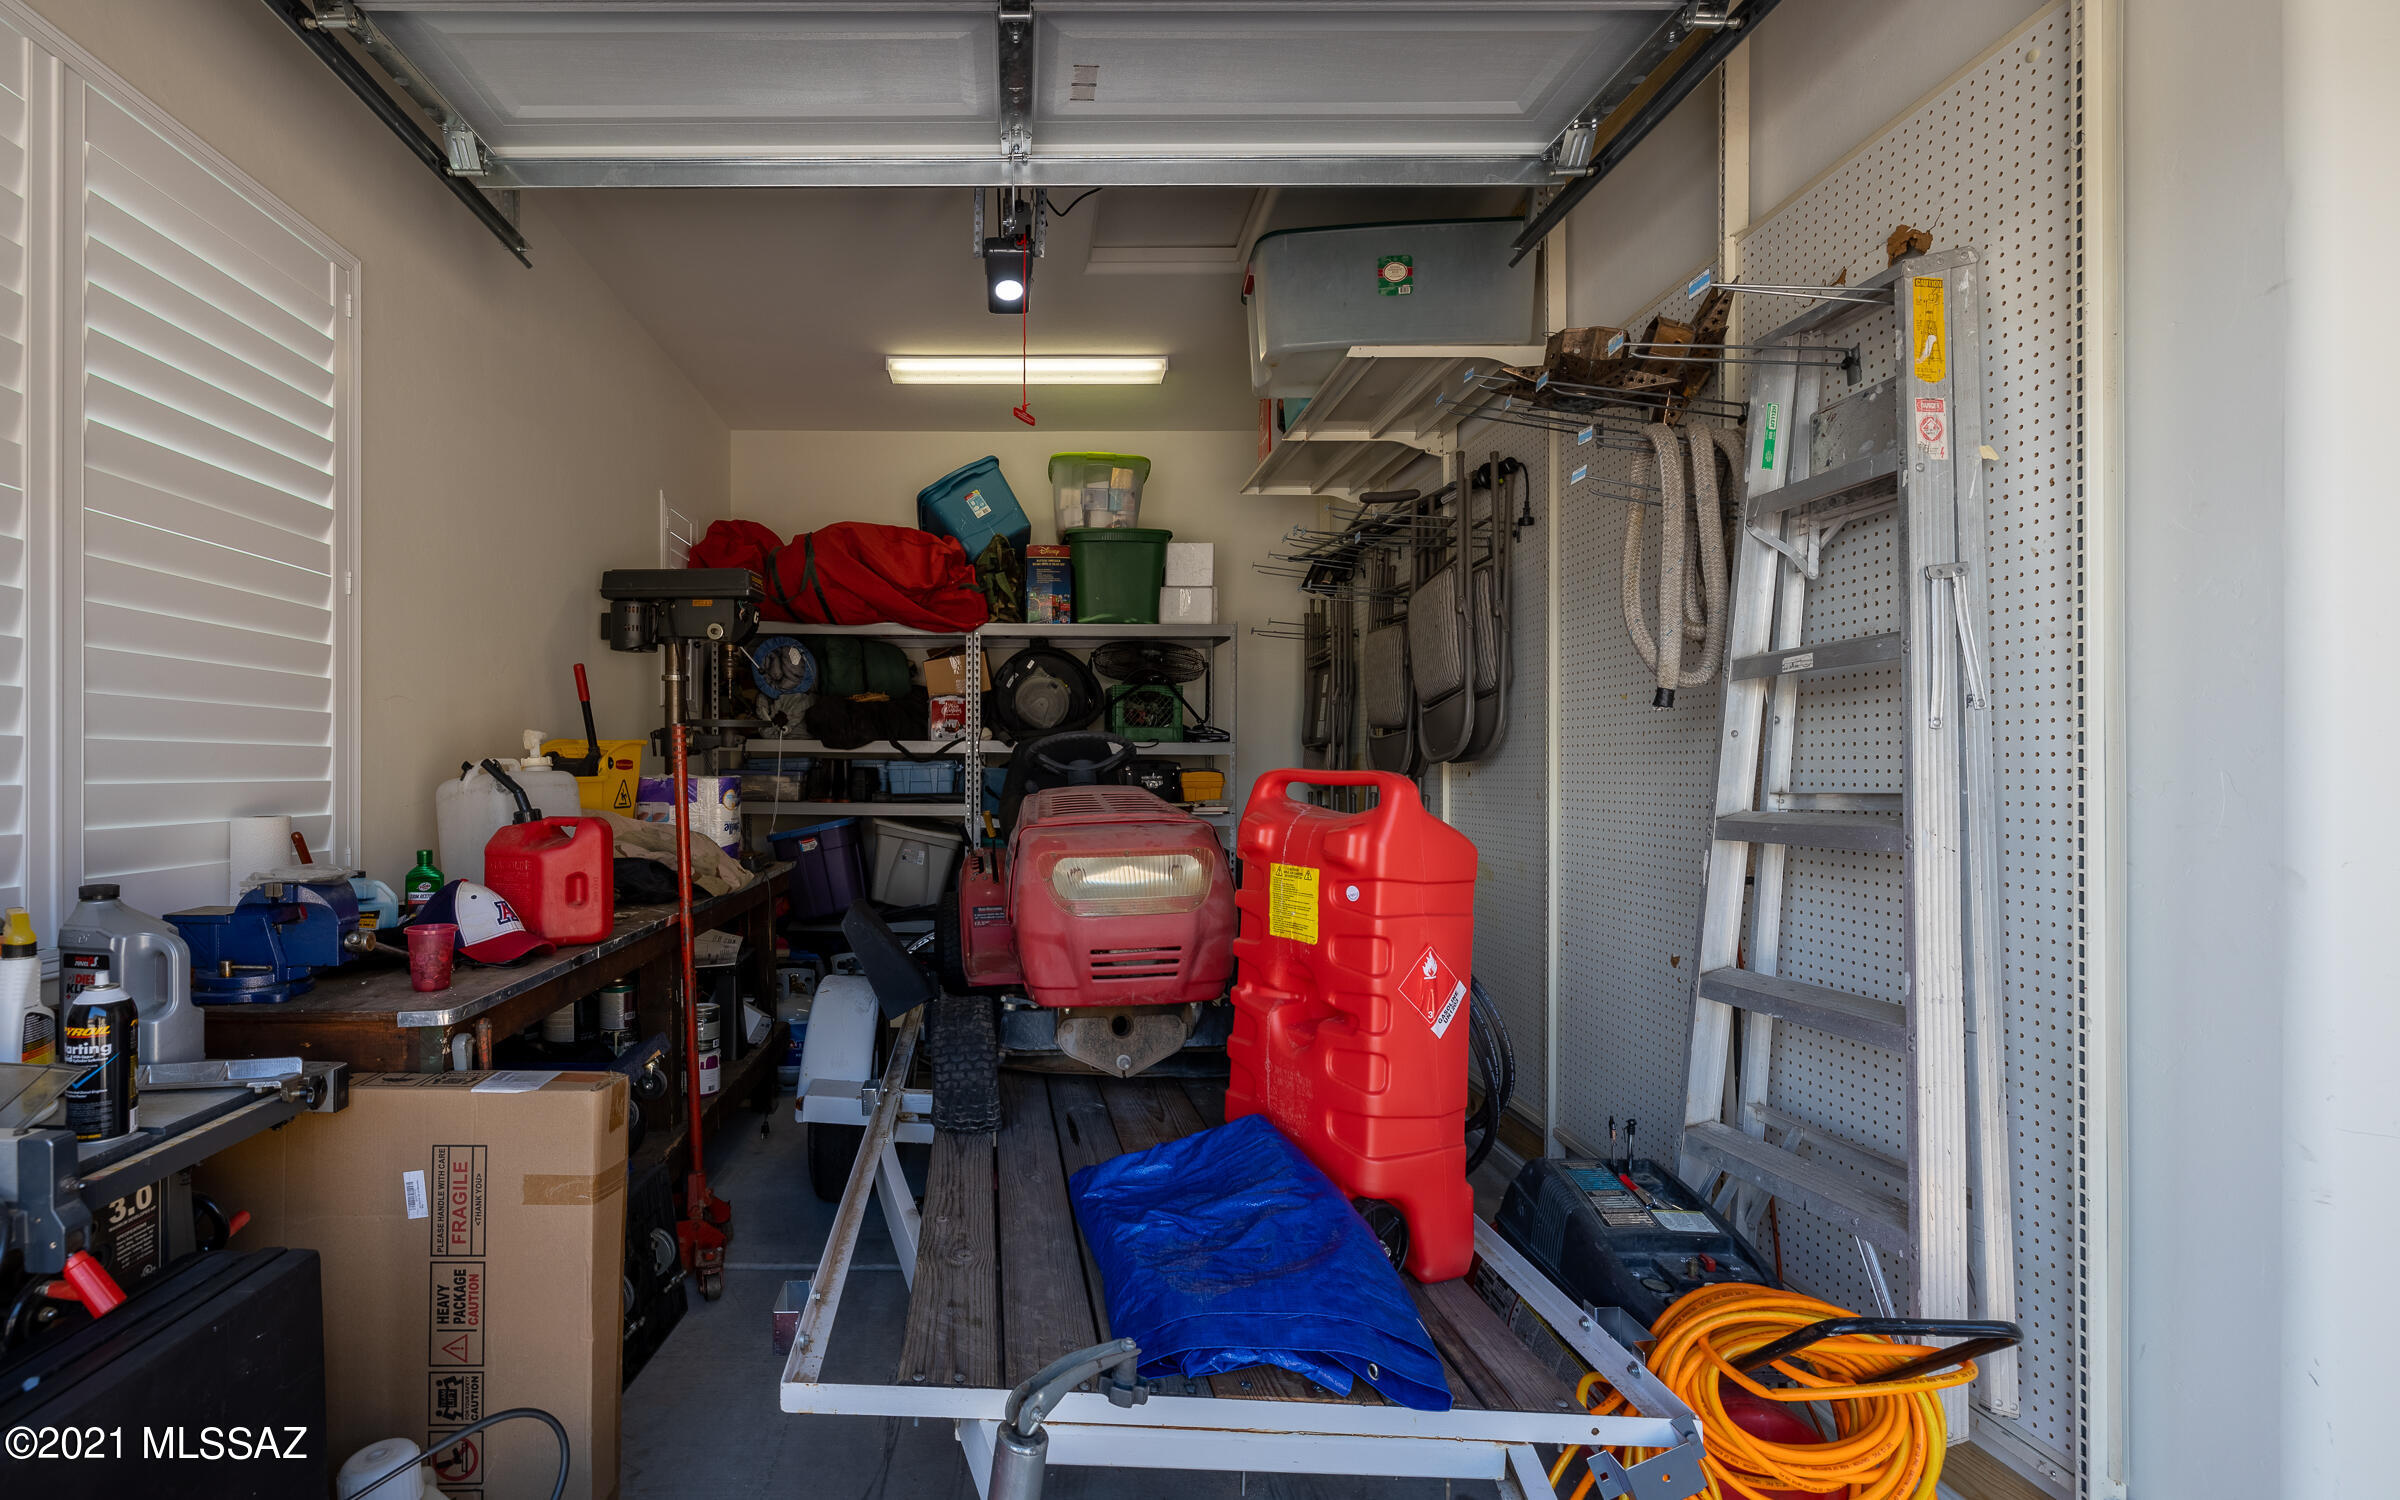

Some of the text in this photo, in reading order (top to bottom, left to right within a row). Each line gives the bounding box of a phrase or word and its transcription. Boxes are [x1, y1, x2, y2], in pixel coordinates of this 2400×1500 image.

[493, 900, 520, 925] A
[1427, 1010, 1434, 1019] 3
[1437, 991, 1459, 1024] GASOLINE
[65, 1042, 113, 1056] arting
[438, 1148, 446, 1169] CARE
[108, 1184, 153, 1224] 3.0
[437, 1191, 445, 1223] HANDLE
[451, 1161, 468, 1245] FRAGILE
[436, 1222, 445, 1253] PLEASE
[436, 1284, 450, 1325] HEAVY
[453, 1268, 467, 1325] PACKAGE
[468, 1273, 479, 1326] CAUTION
[470, 1375, 480, 1421] CAUTION
